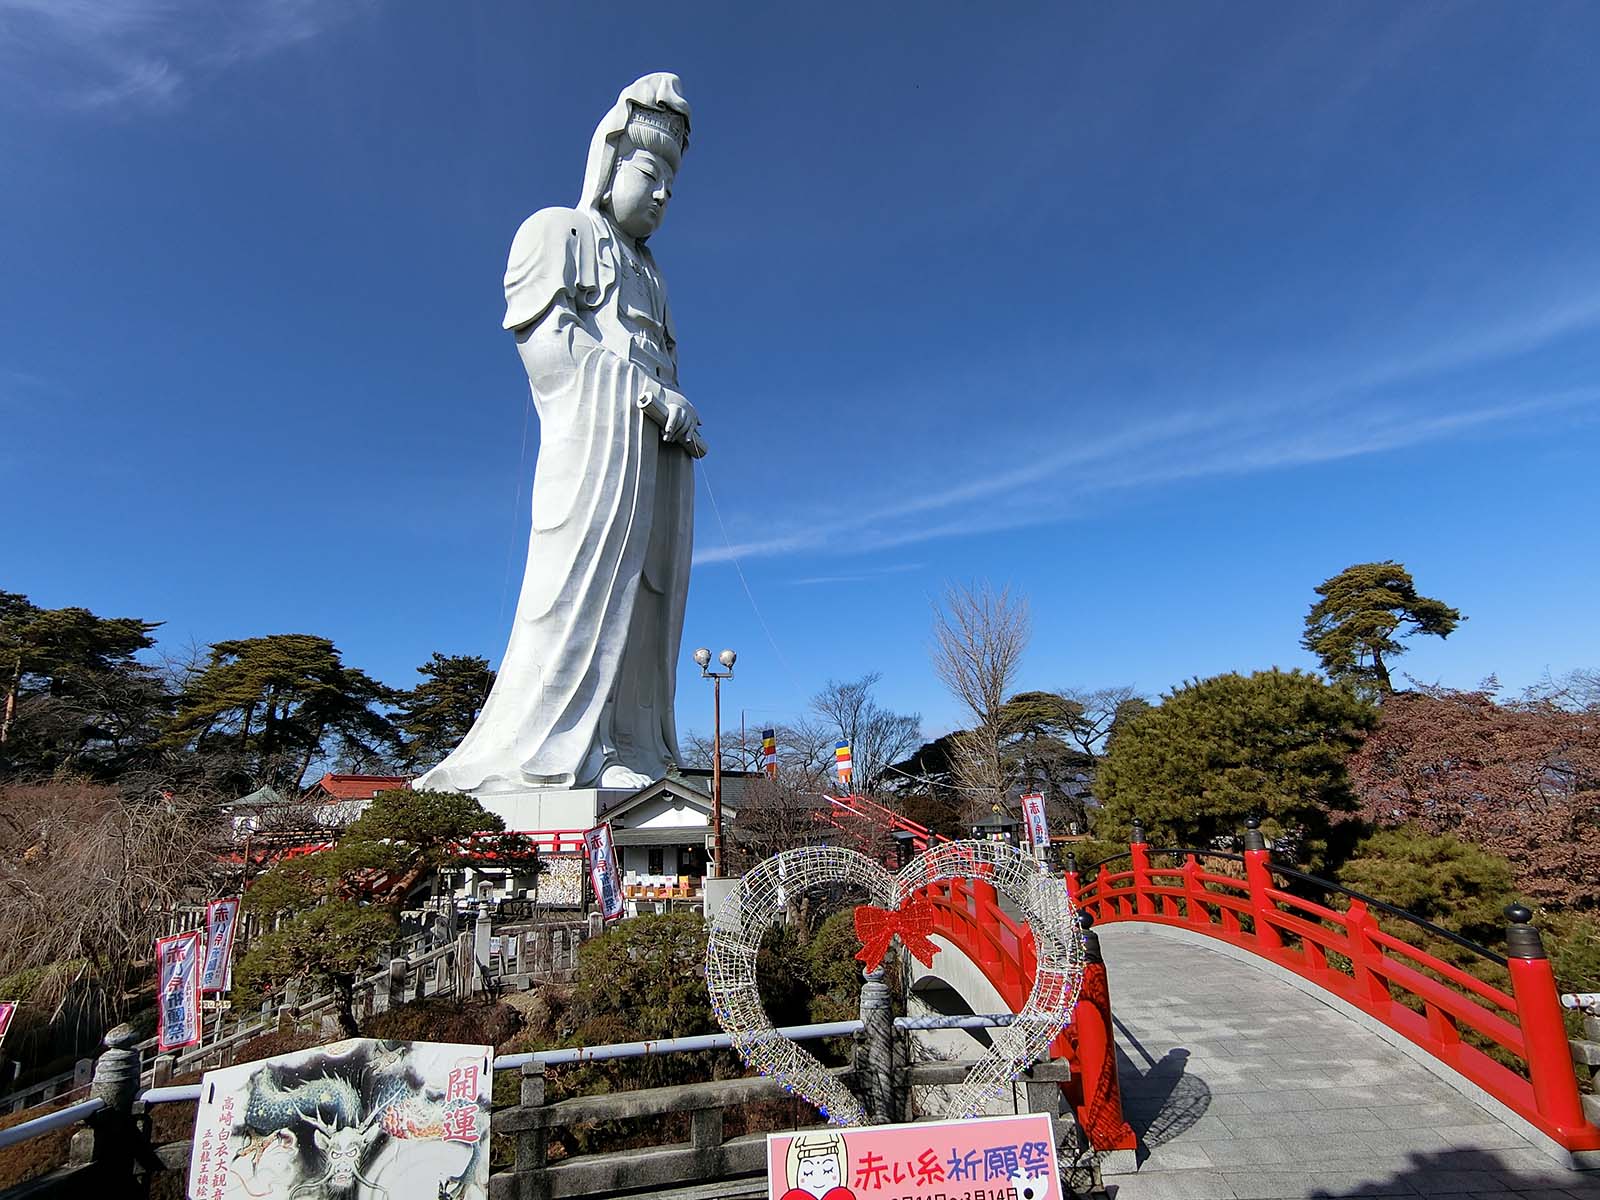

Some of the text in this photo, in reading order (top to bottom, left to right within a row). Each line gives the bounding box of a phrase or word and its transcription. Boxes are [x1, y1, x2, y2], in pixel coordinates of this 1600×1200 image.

[166, 943, 187, 1040] 赤い糸祈願祭
[443, 1064, 480, 1142] 開運
[196, 1129, 213, 1200] 五色龍王襖絵
[854, 1141, 1051, 1191] 赤い糸祈願祭
